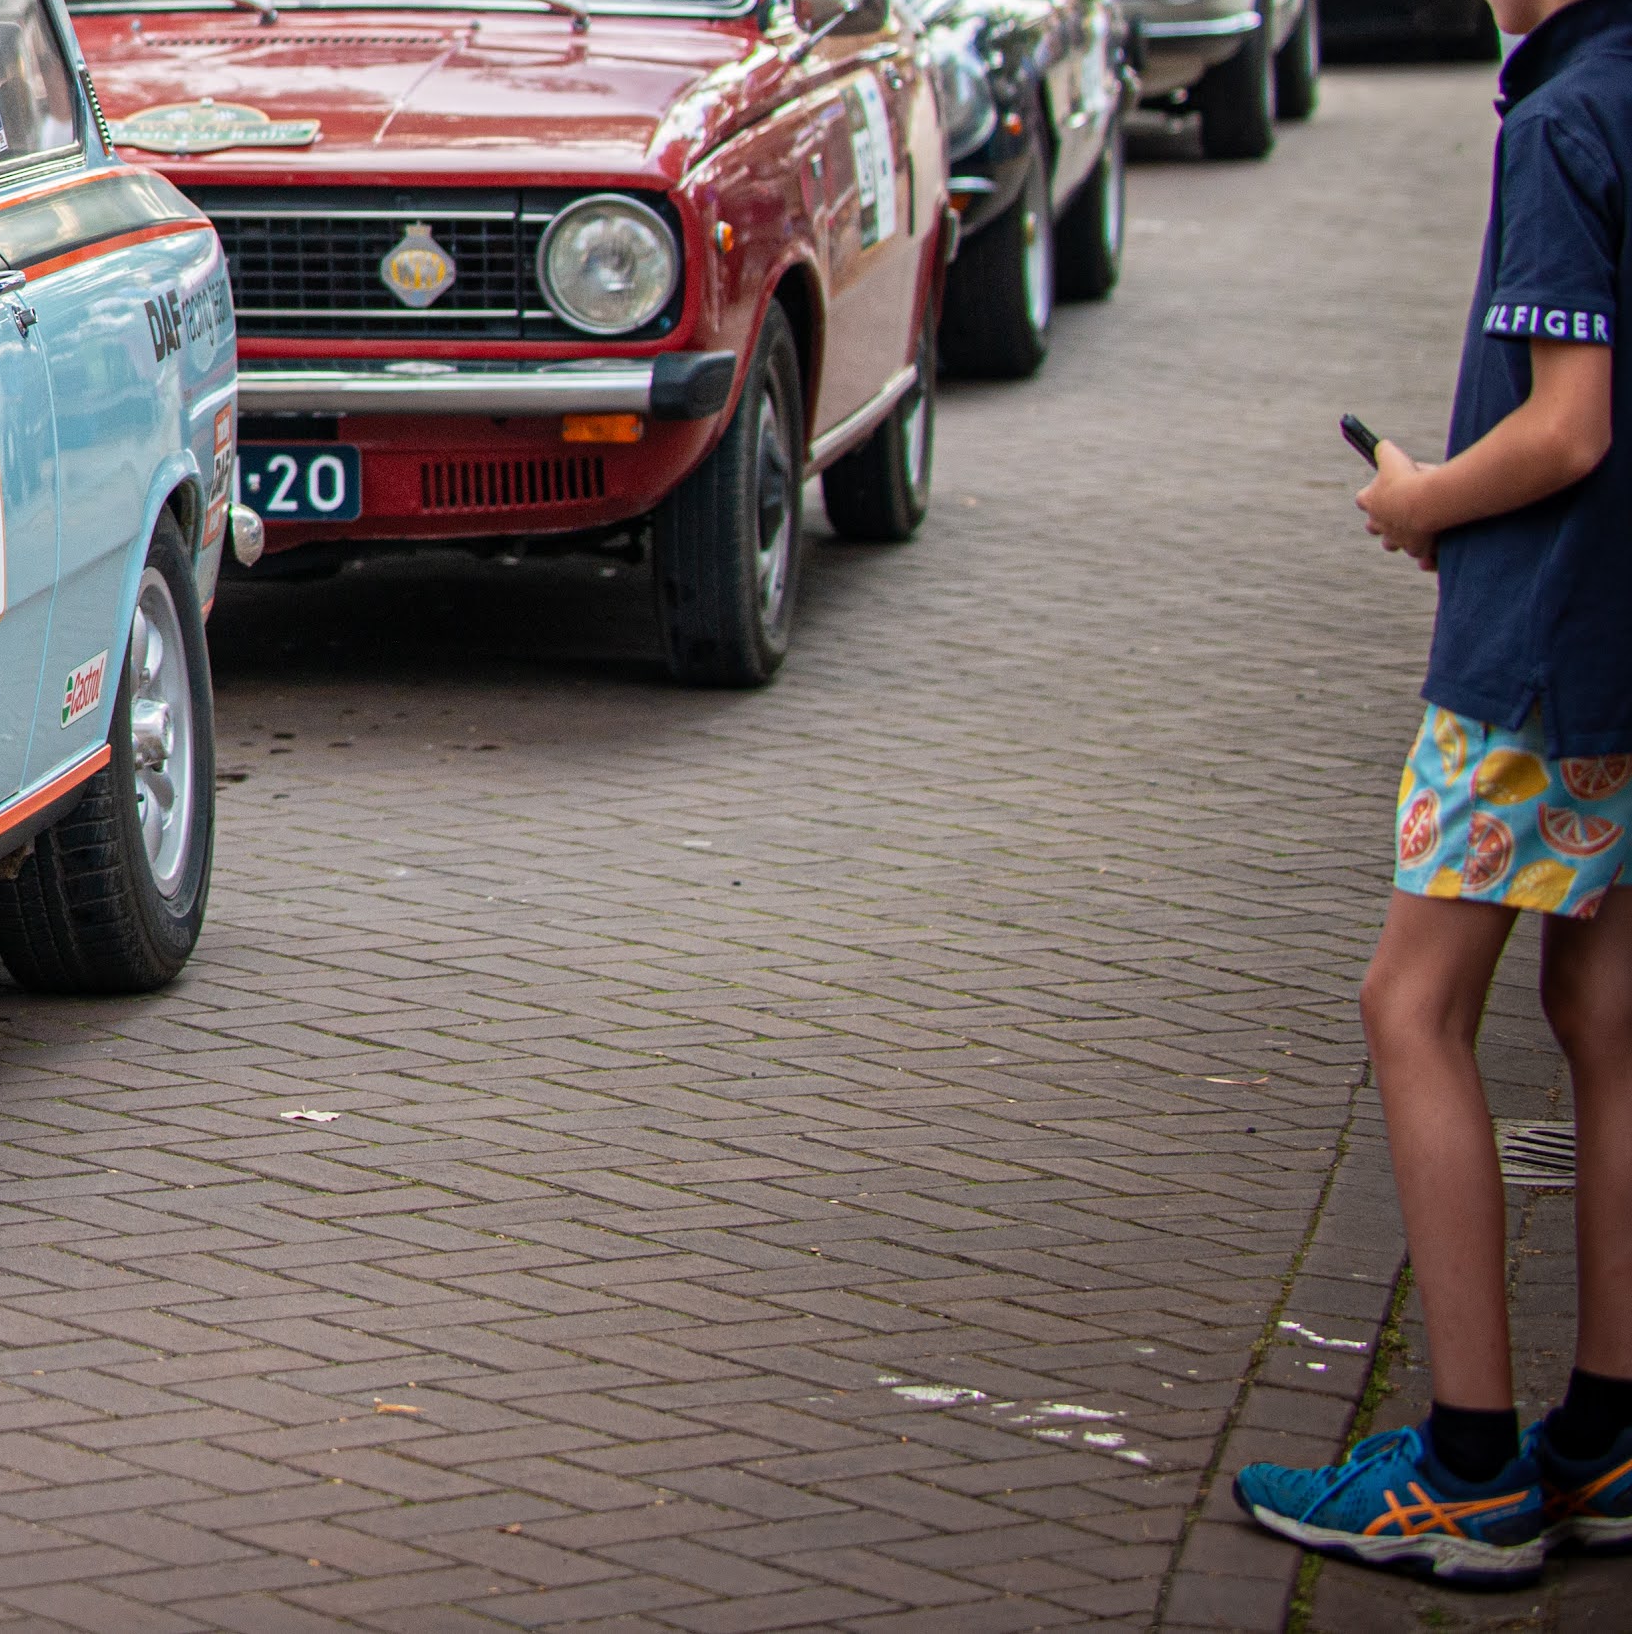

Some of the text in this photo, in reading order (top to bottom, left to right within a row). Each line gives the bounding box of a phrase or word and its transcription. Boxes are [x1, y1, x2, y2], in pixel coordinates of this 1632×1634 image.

[144, 288, 182, 363] DAF
[181, 284, 214, 347] racing
[70, 656, 105, 717] Castrol
